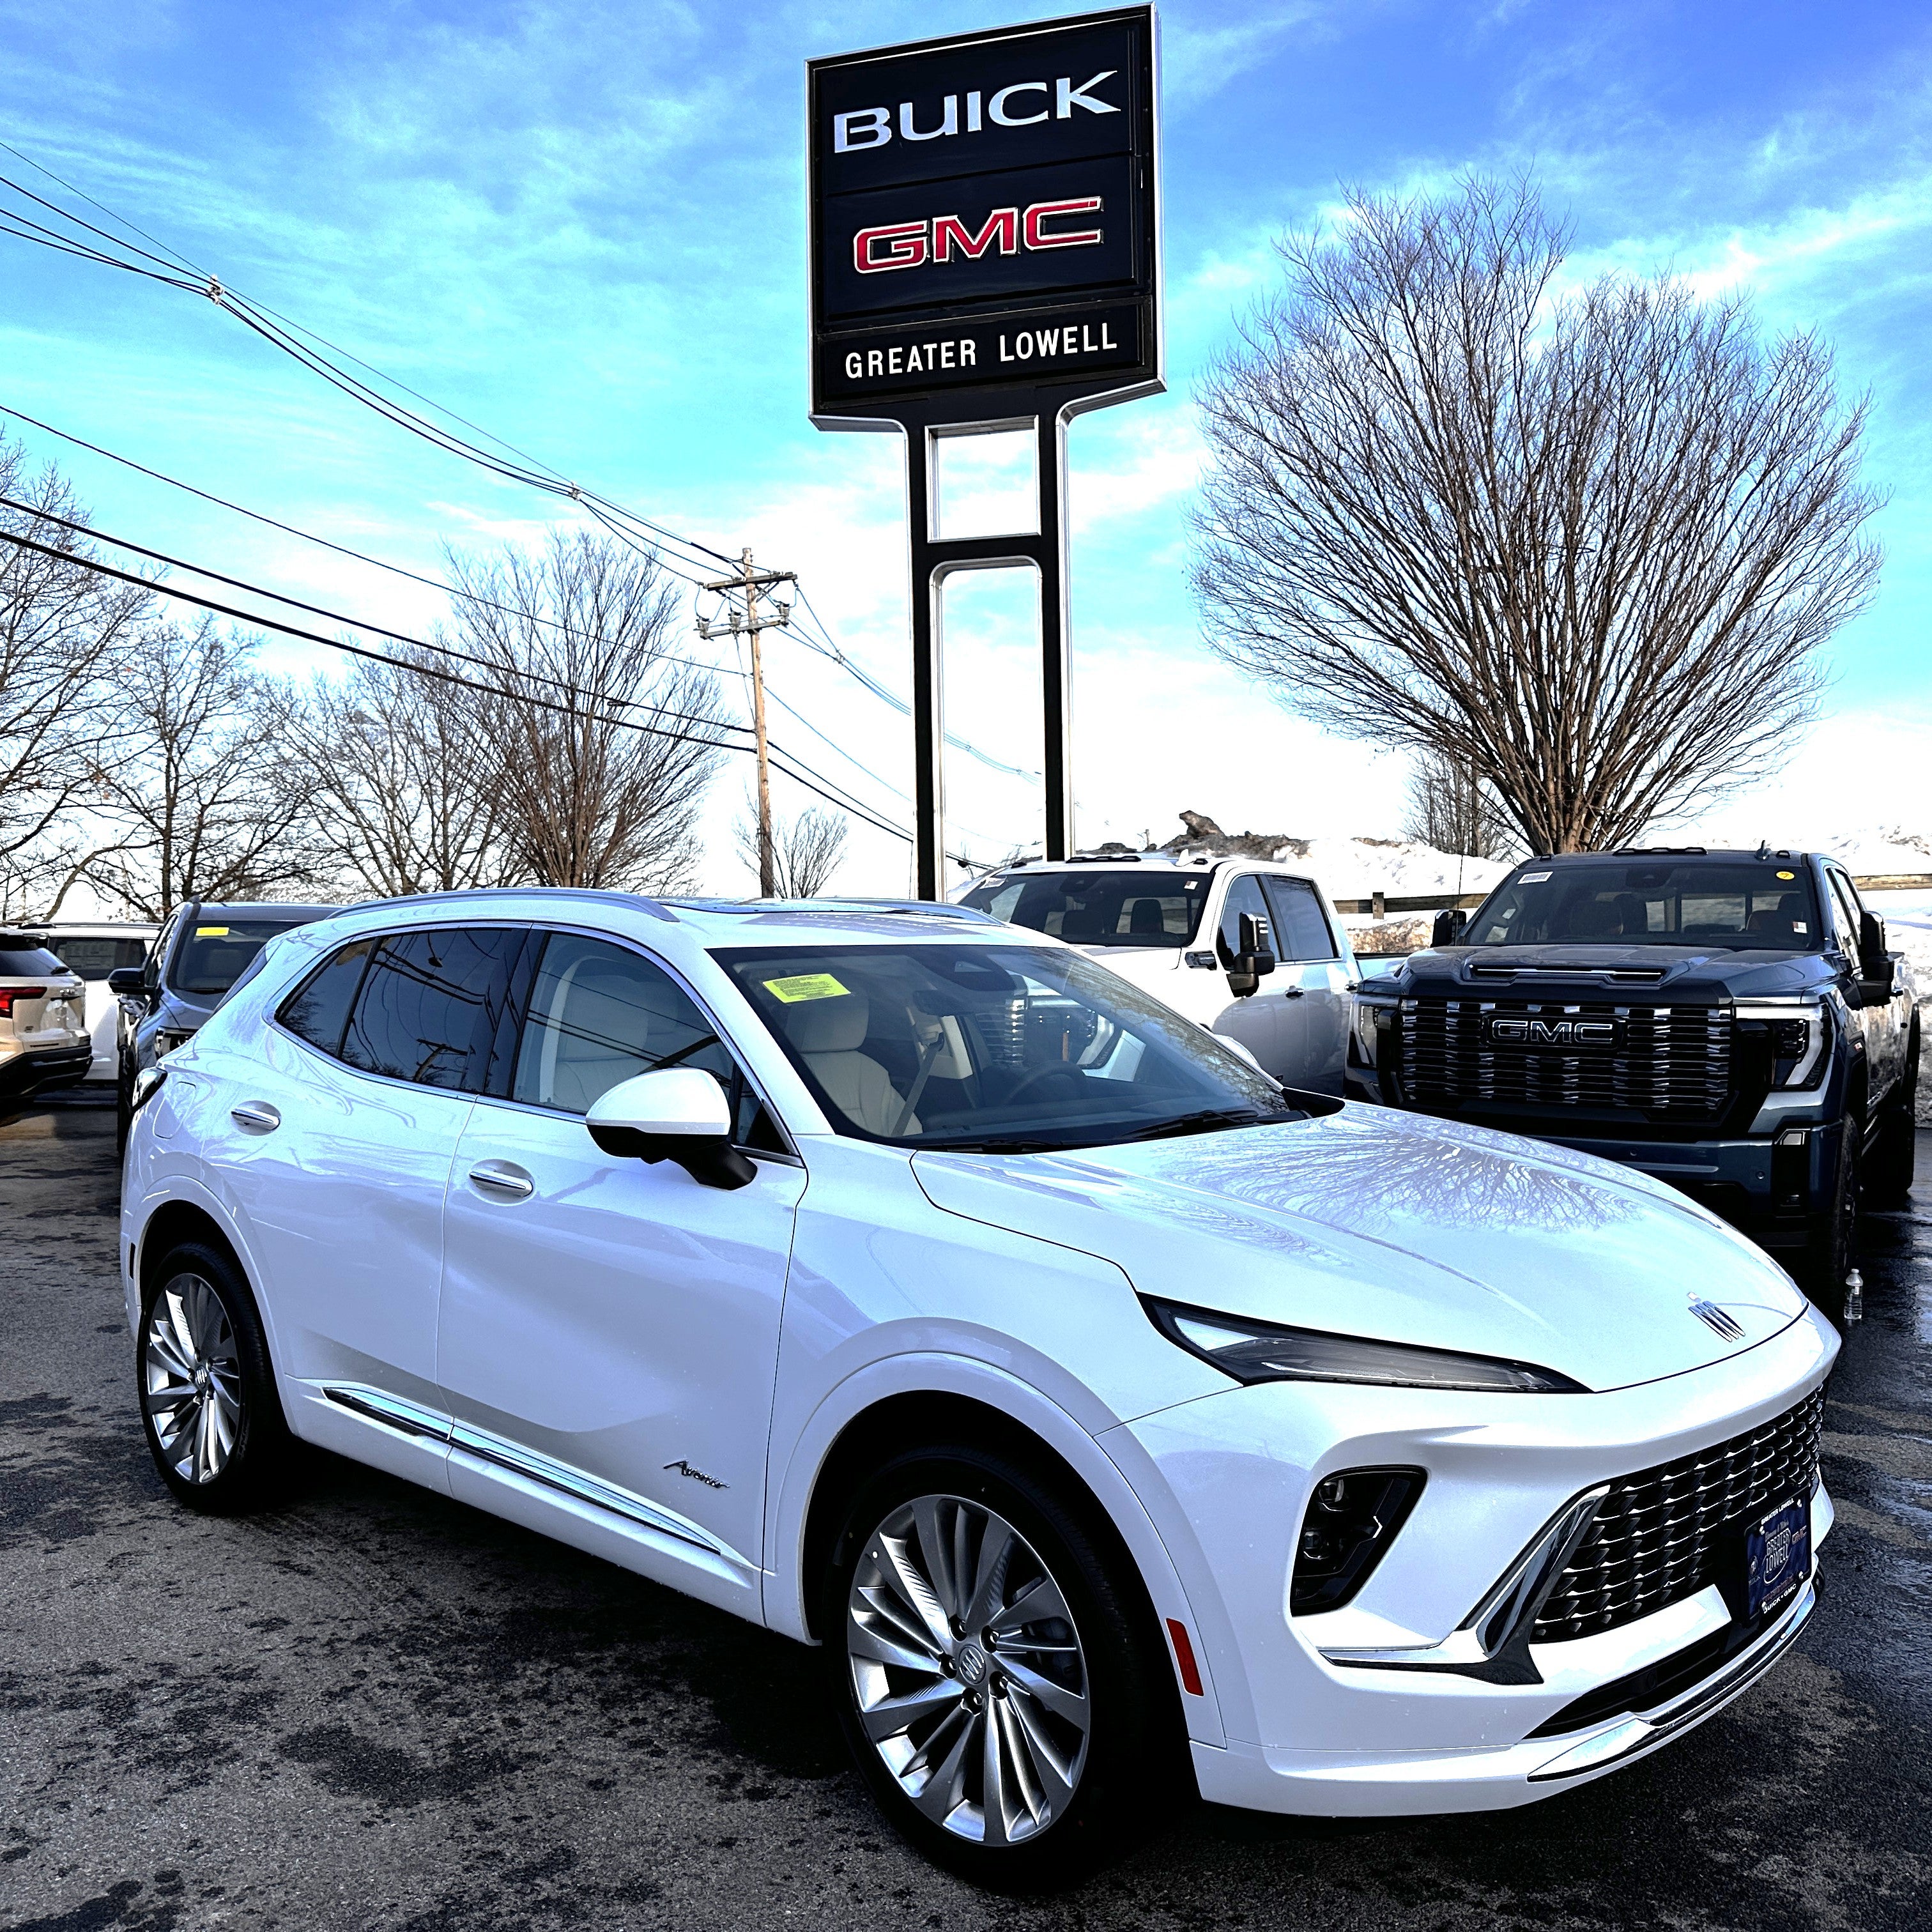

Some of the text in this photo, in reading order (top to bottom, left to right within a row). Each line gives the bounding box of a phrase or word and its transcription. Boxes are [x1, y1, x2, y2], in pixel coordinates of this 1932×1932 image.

[834, 70, 1121, 153] BUICK
[854, 196, 1104, 274] GMC
[846, 323, 1117, 378] GREATER LOWELL
[1492, 1020, 1613, 1043] GMC
[1766, 1544, 1789, 1574] LOWELL
[1784, 1584, 1797, 1597] GMC
